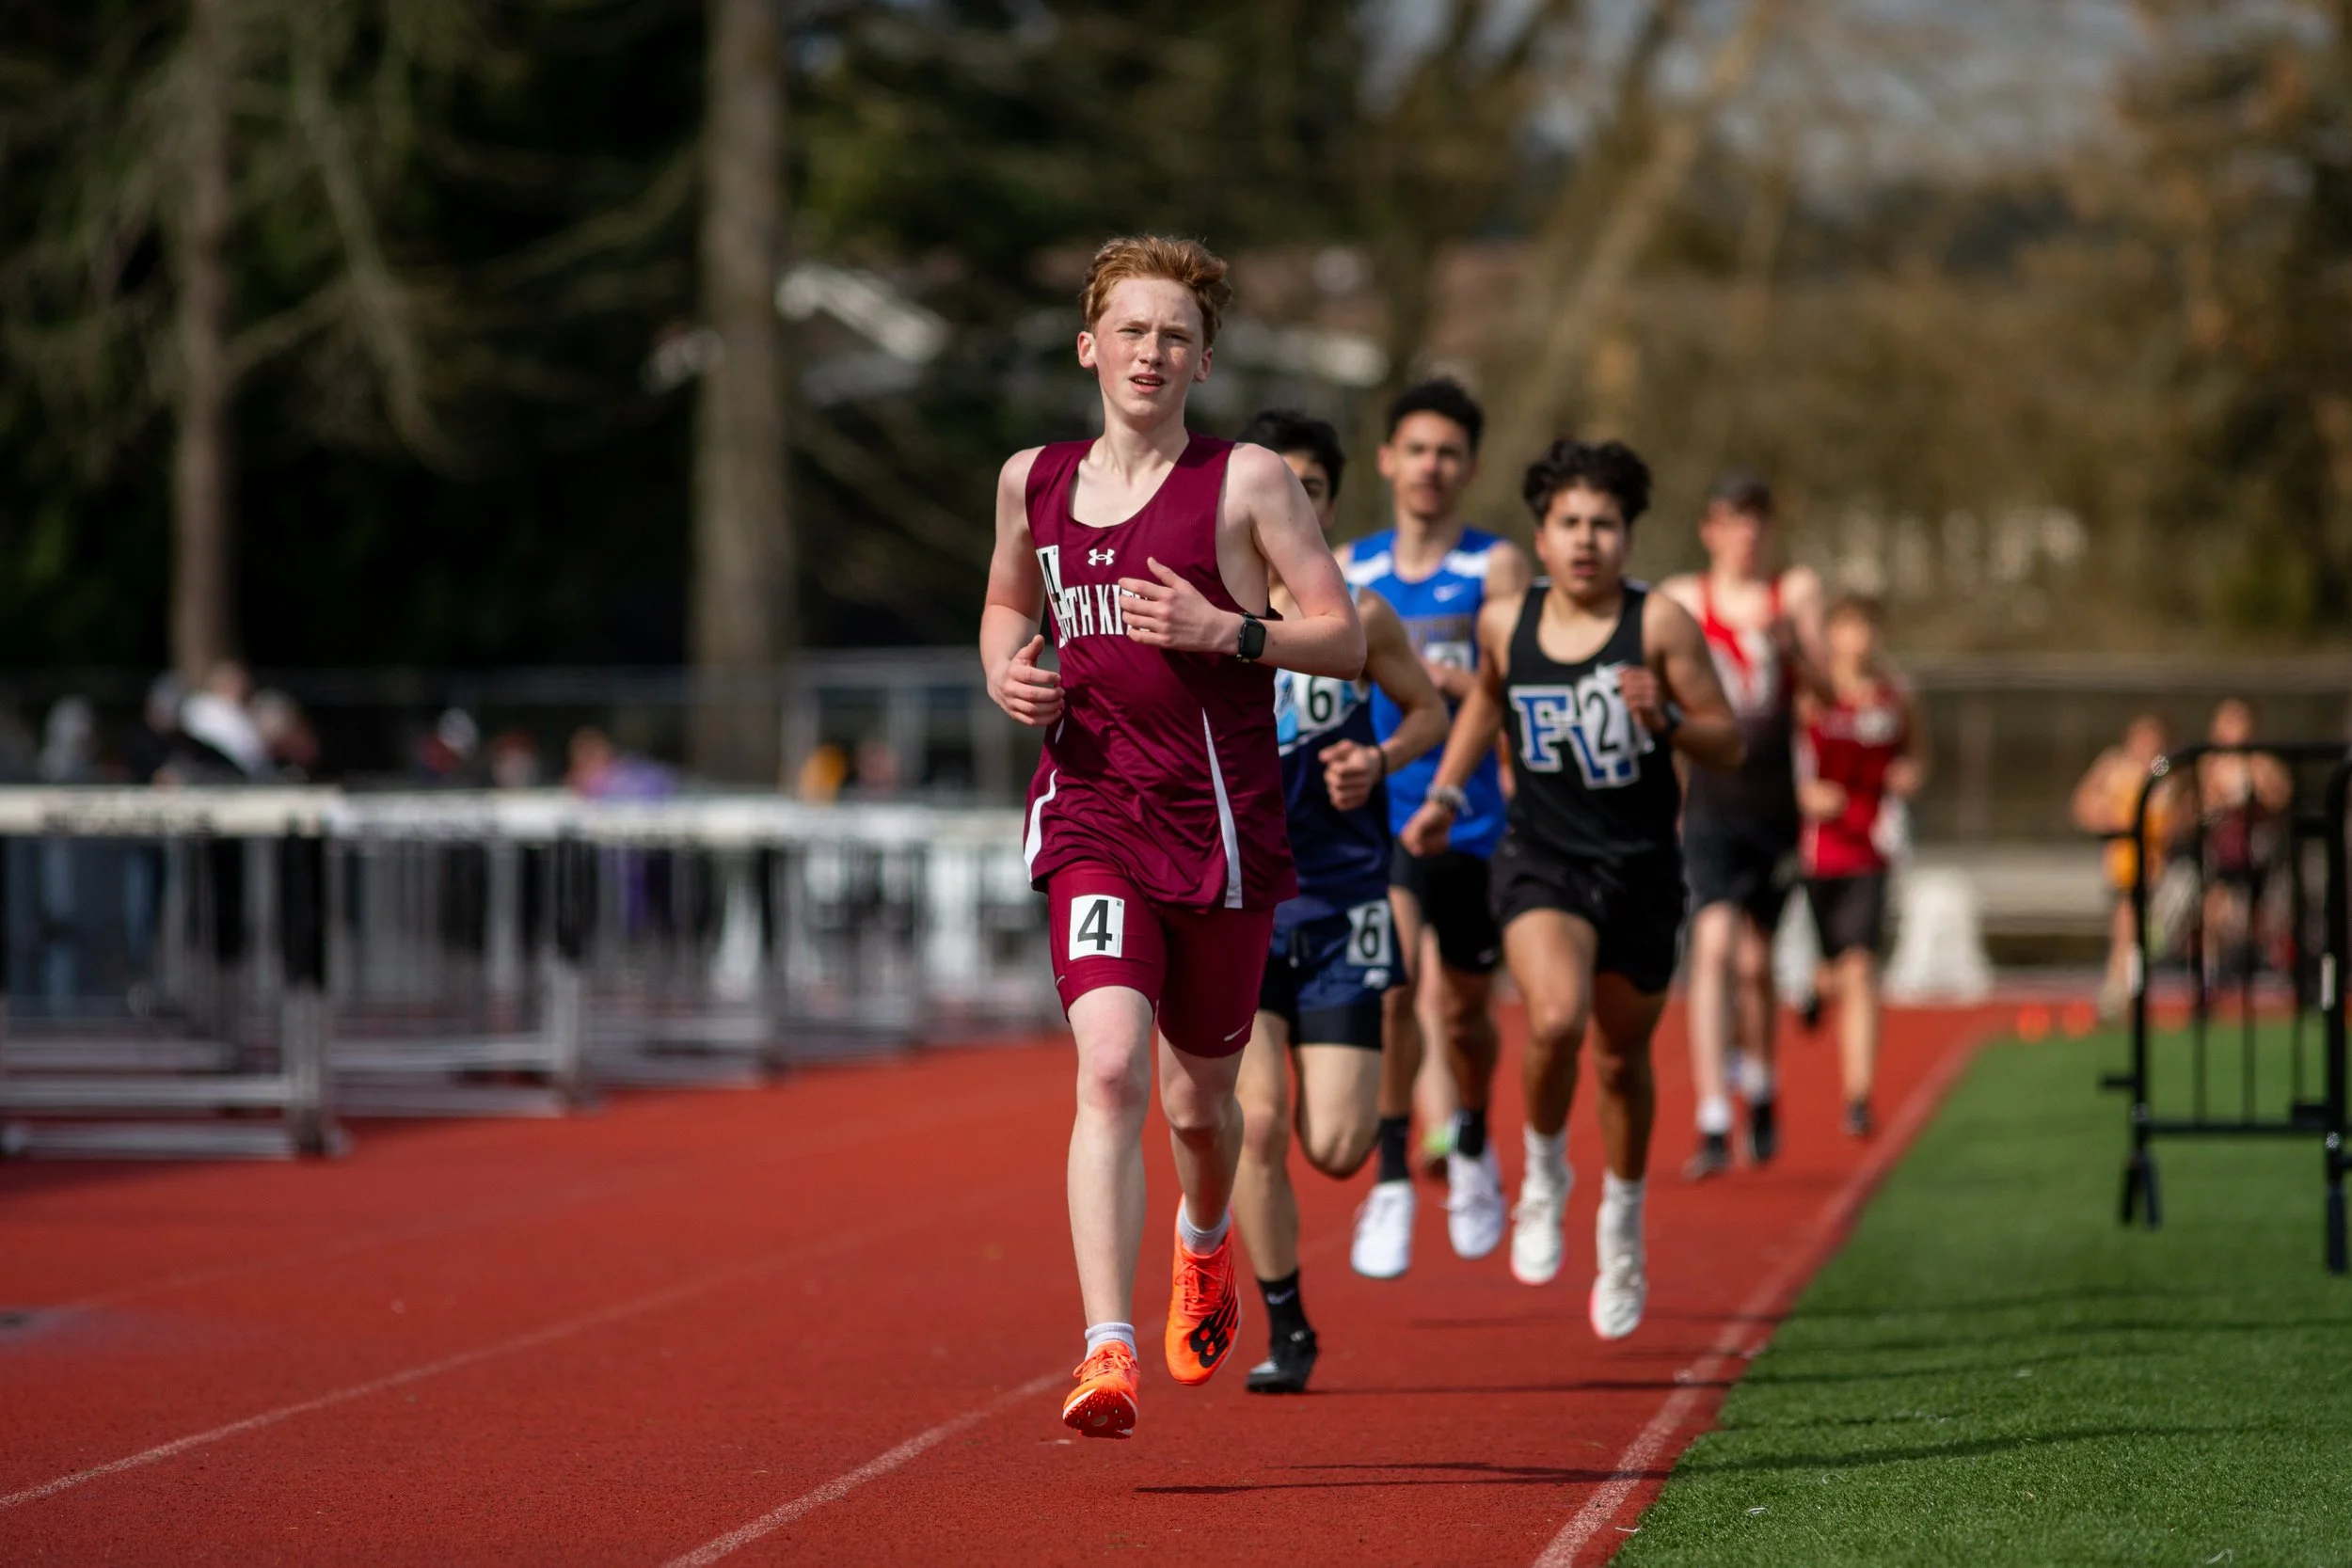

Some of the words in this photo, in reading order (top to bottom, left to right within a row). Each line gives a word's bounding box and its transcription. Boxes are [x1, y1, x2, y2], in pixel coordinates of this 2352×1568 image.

[1309, 676, 1332, 723] 6
[1077, 898, 1113, 951] 4
[1359, 909, 1381, 958] 6
